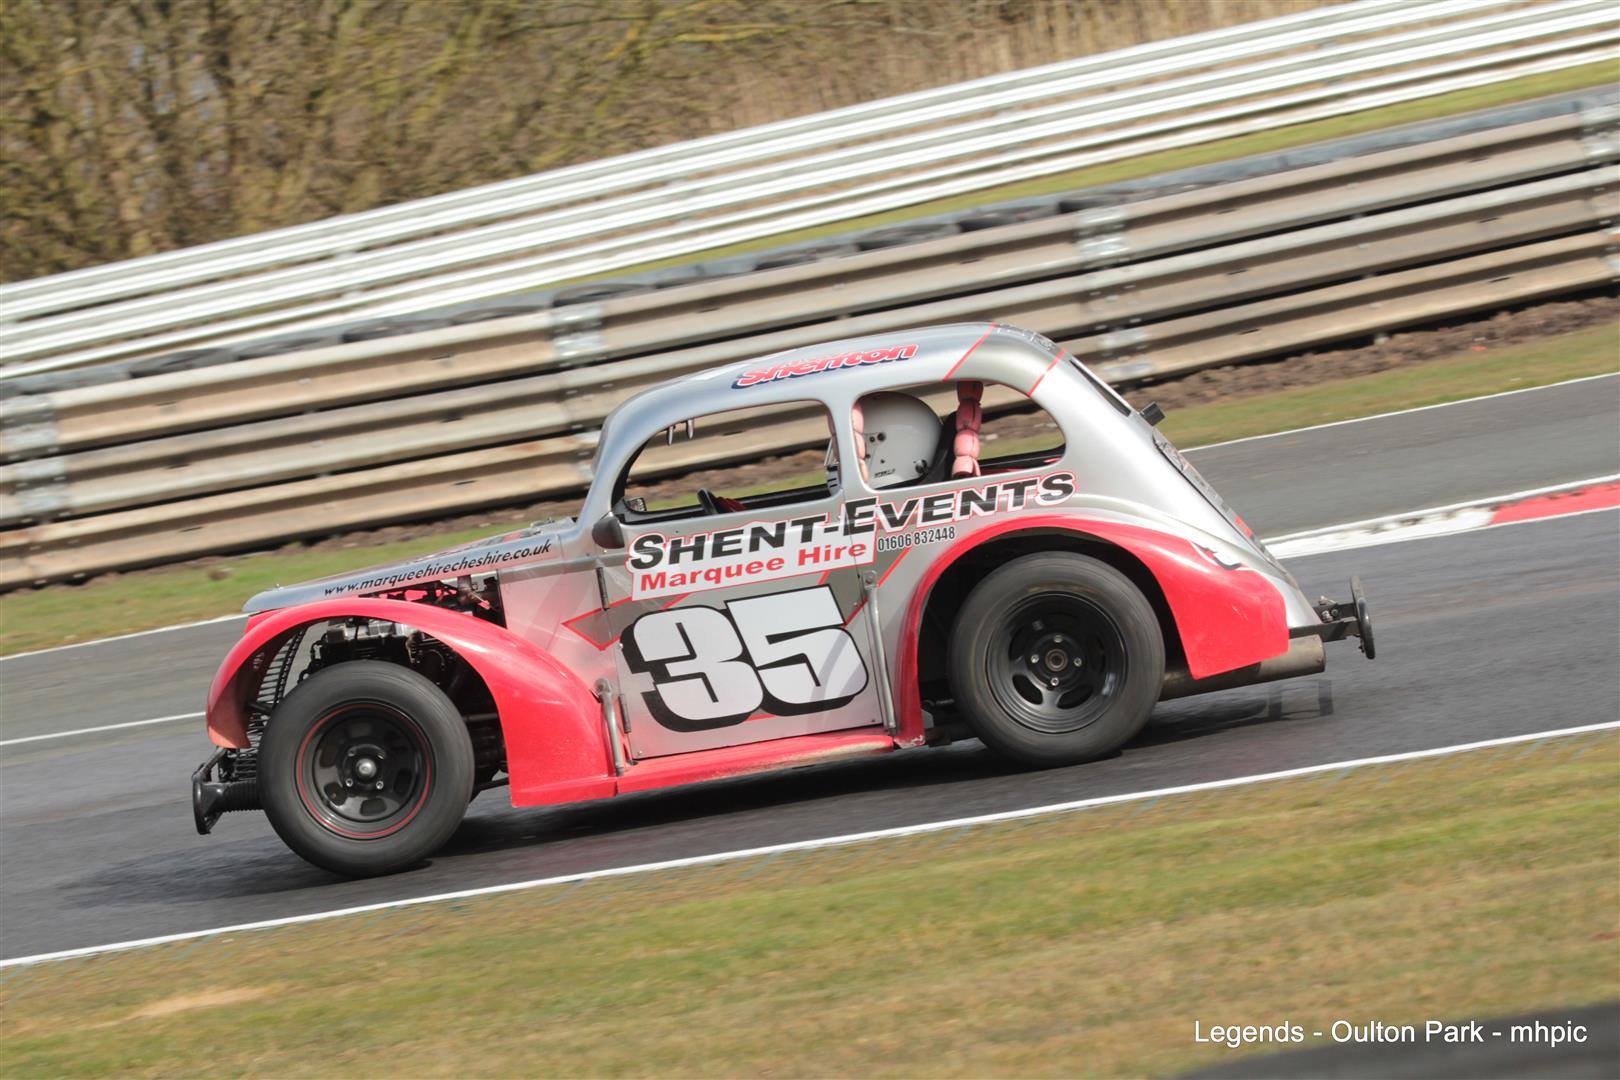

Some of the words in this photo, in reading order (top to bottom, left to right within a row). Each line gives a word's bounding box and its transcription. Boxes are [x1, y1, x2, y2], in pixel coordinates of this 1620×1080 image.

[732, 344, 918, 389] Shenton
[877, 531, 912, 552] 01606
[913, 525, 956, 548] 832448
[323, 538, 552, 597] www.marqueehirecheshire.co.uk
[640, 556, 785, 593] Marquee
[797, 542, 867, 568] Hire
[620, 584, 869, 732] 35
